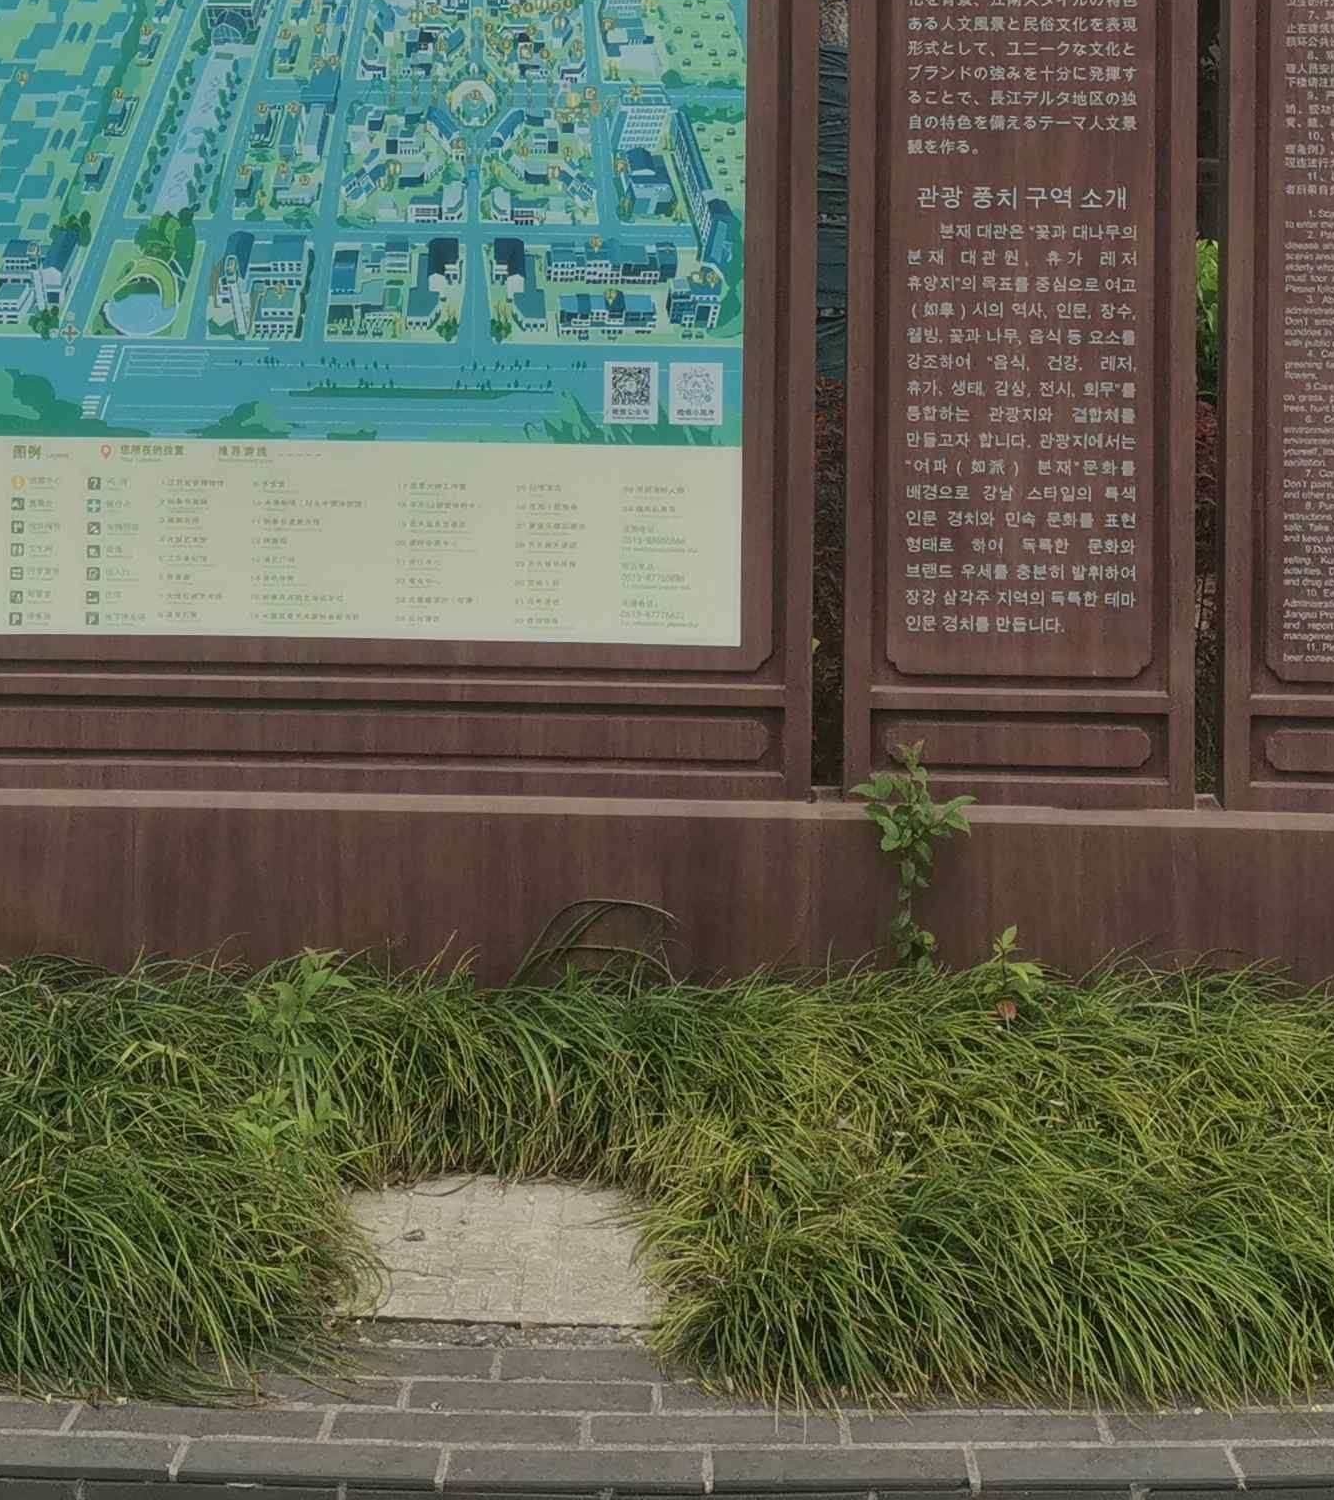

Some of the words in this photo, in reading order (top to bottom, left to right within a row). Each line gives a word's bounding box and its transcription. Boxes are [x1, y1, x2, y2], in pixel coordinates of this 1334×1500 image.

[916, 184, 964, 209] 관광
[1024, 183, 1073, 210] 구역
[1079, 185, 1127, 211] 소개
